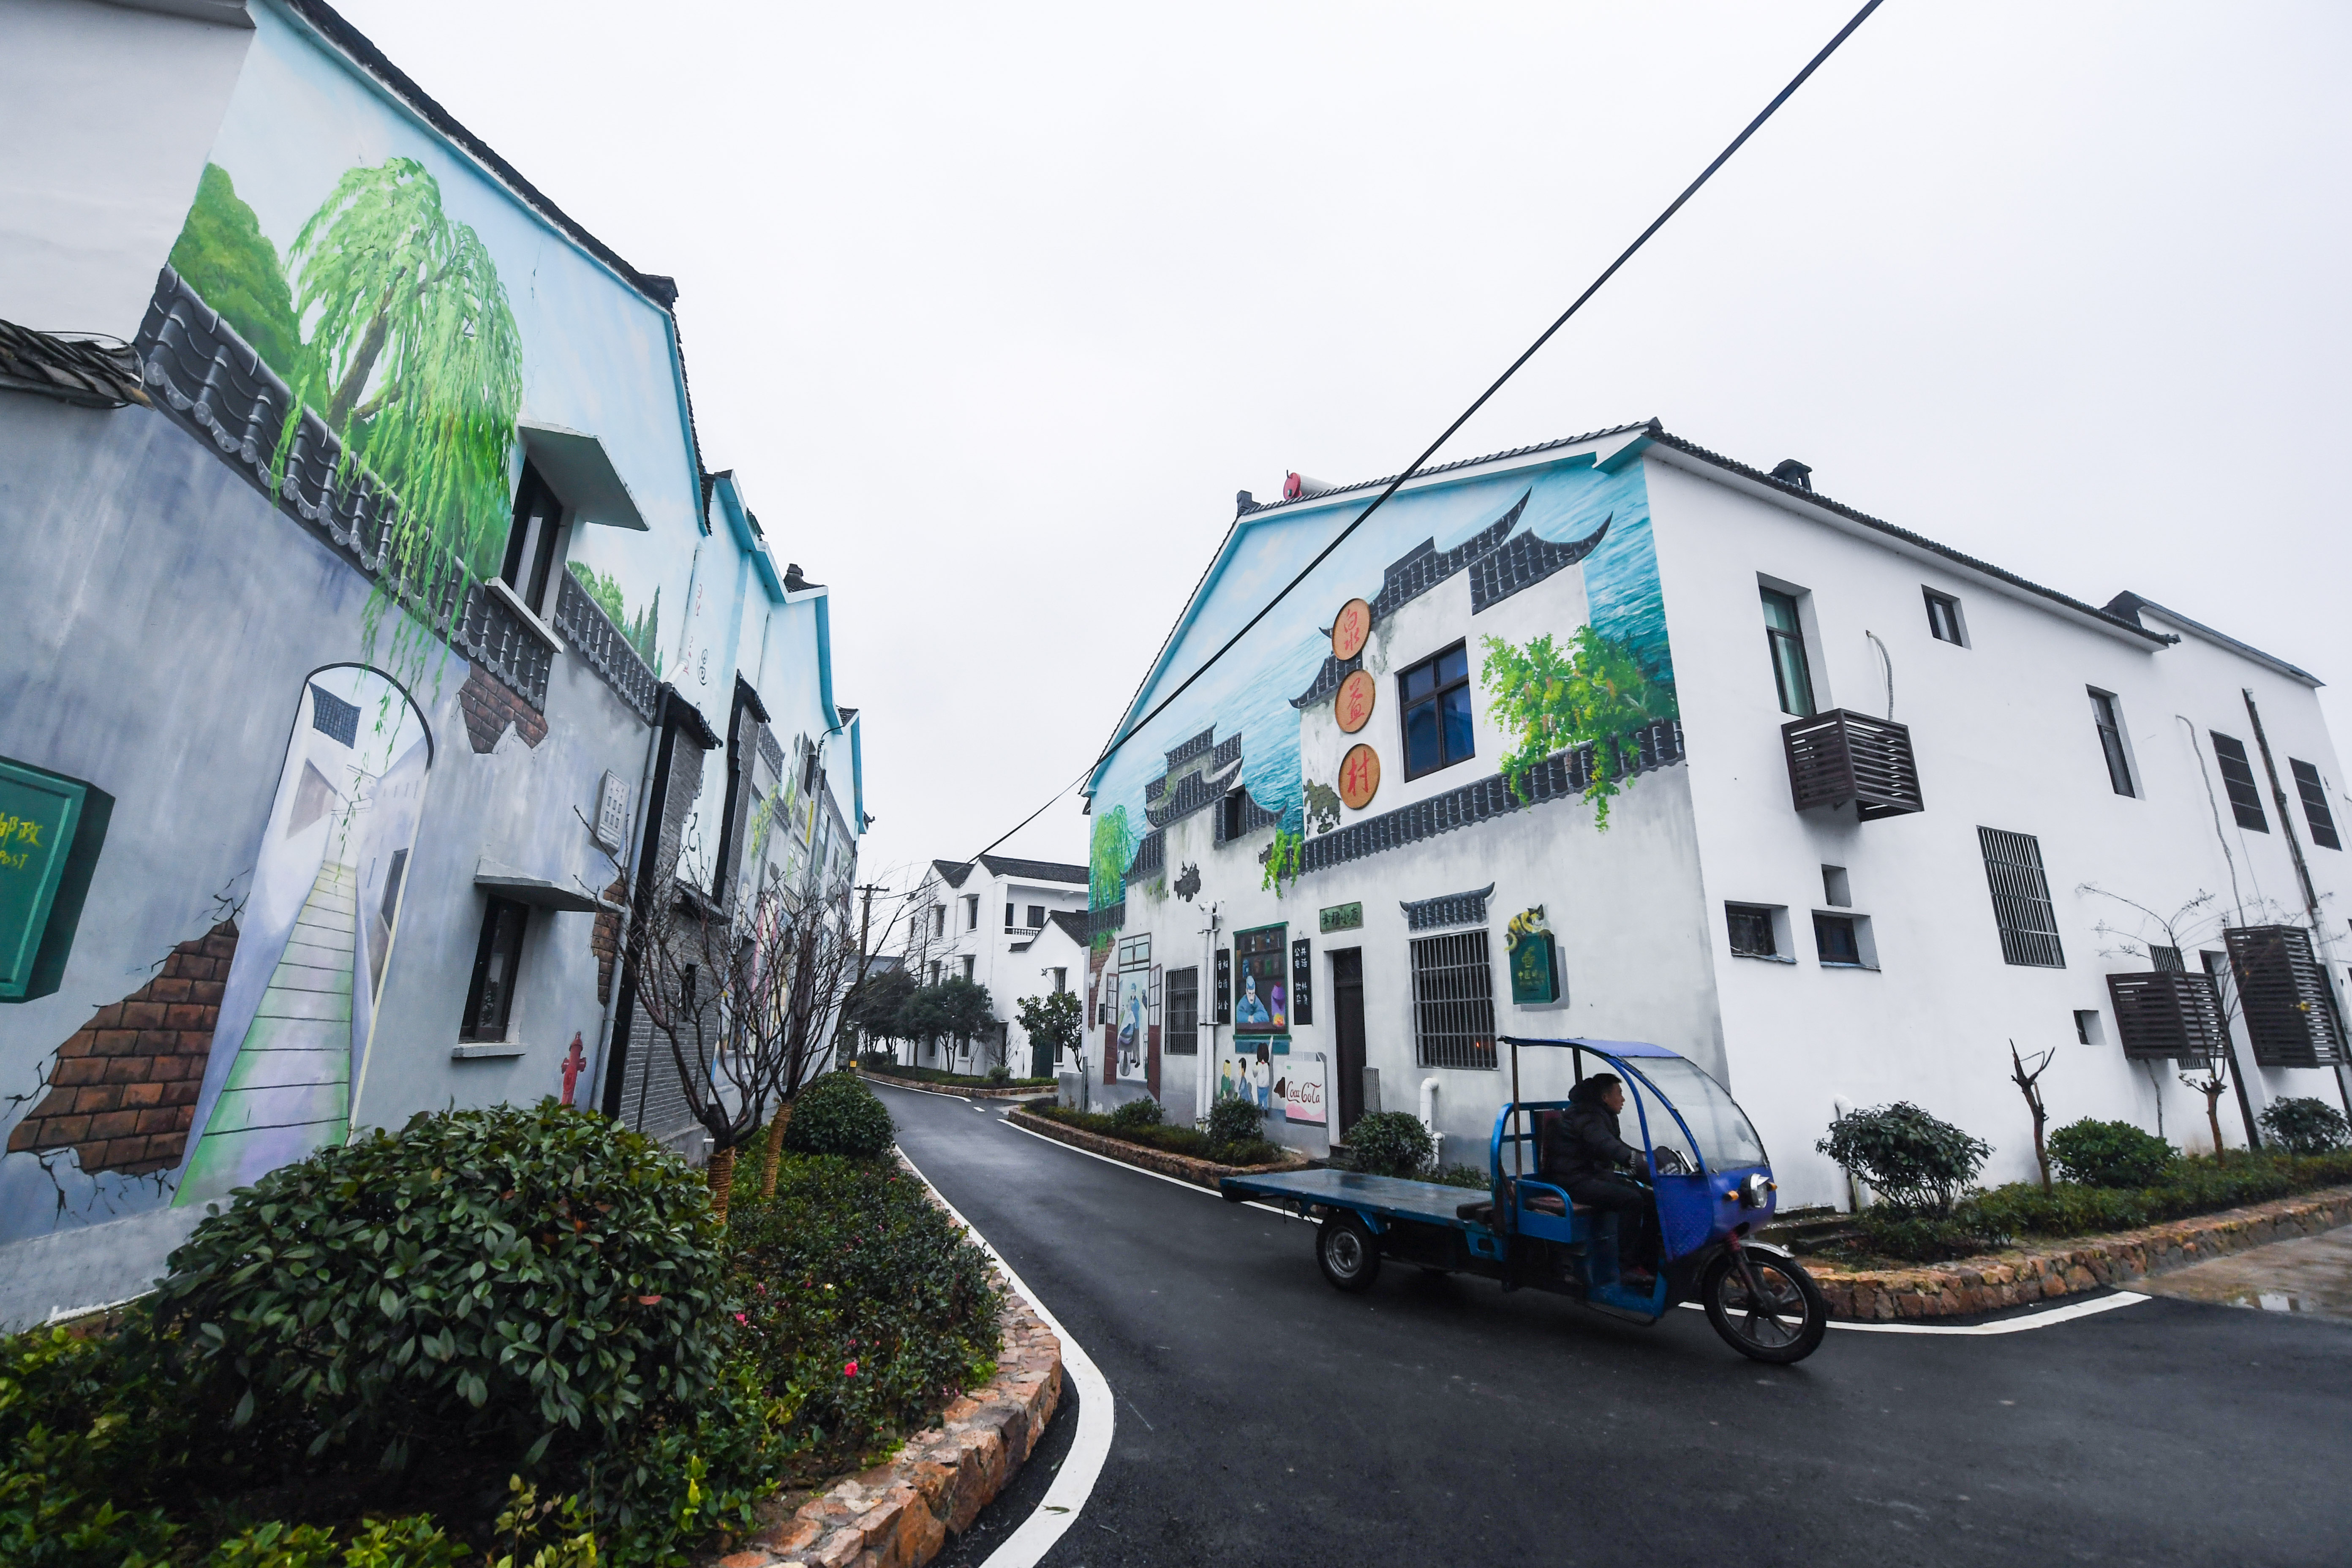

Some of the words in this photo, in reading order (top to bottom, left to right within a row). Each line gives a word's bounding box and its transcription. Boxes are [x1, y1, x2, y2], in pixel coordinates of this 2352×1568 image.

[1322, 906, 1358, 927] 幸福小店
[1295, 946, 1307, 957] 公共
[1217, 960, 1228, 970] 香烟
[1295, 958, 1307, 969] 电话
